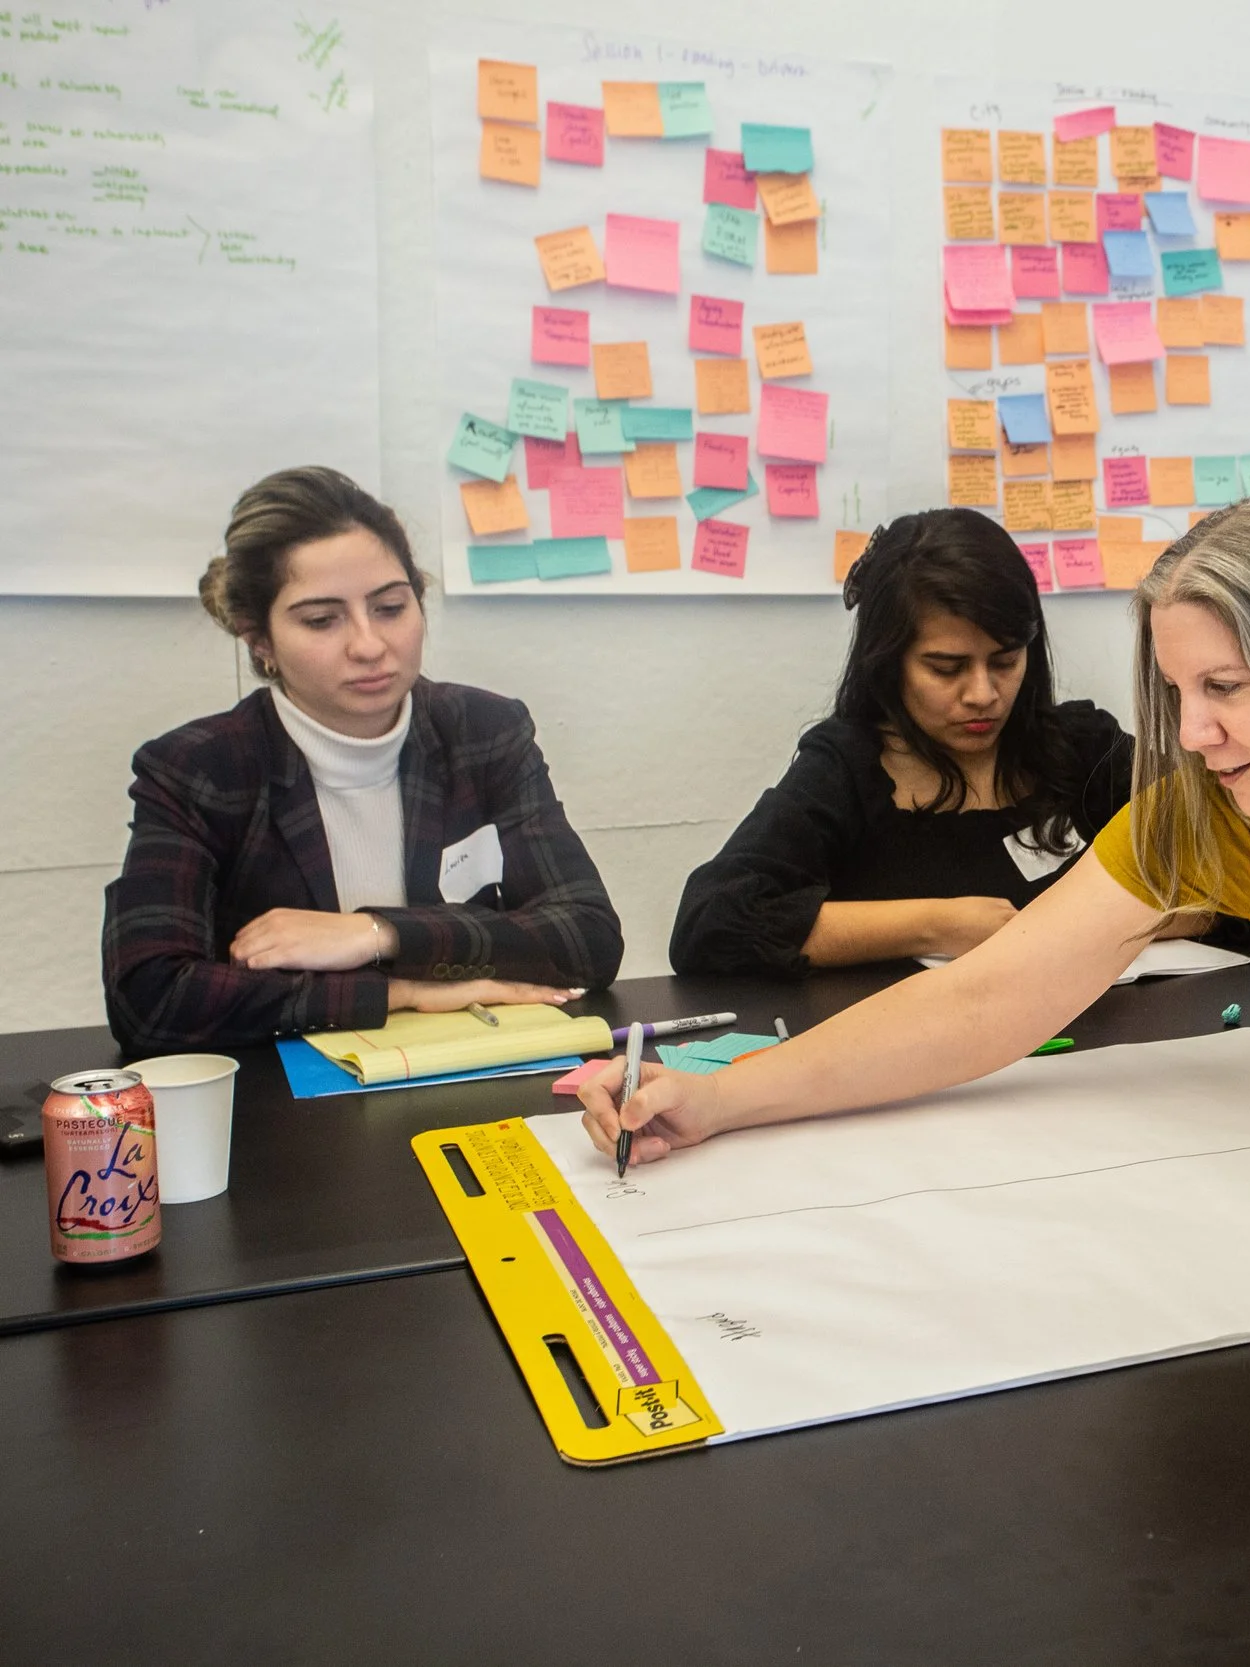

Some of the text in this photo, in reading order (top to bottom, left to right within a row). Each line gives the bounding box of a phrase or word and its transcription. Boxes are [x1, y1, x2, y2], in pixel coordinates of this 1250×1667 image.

[969, 102, 1003, 124] City
[97, 1121, 146, 1181] La
[634, 1386, 675, 1431] Post-it
